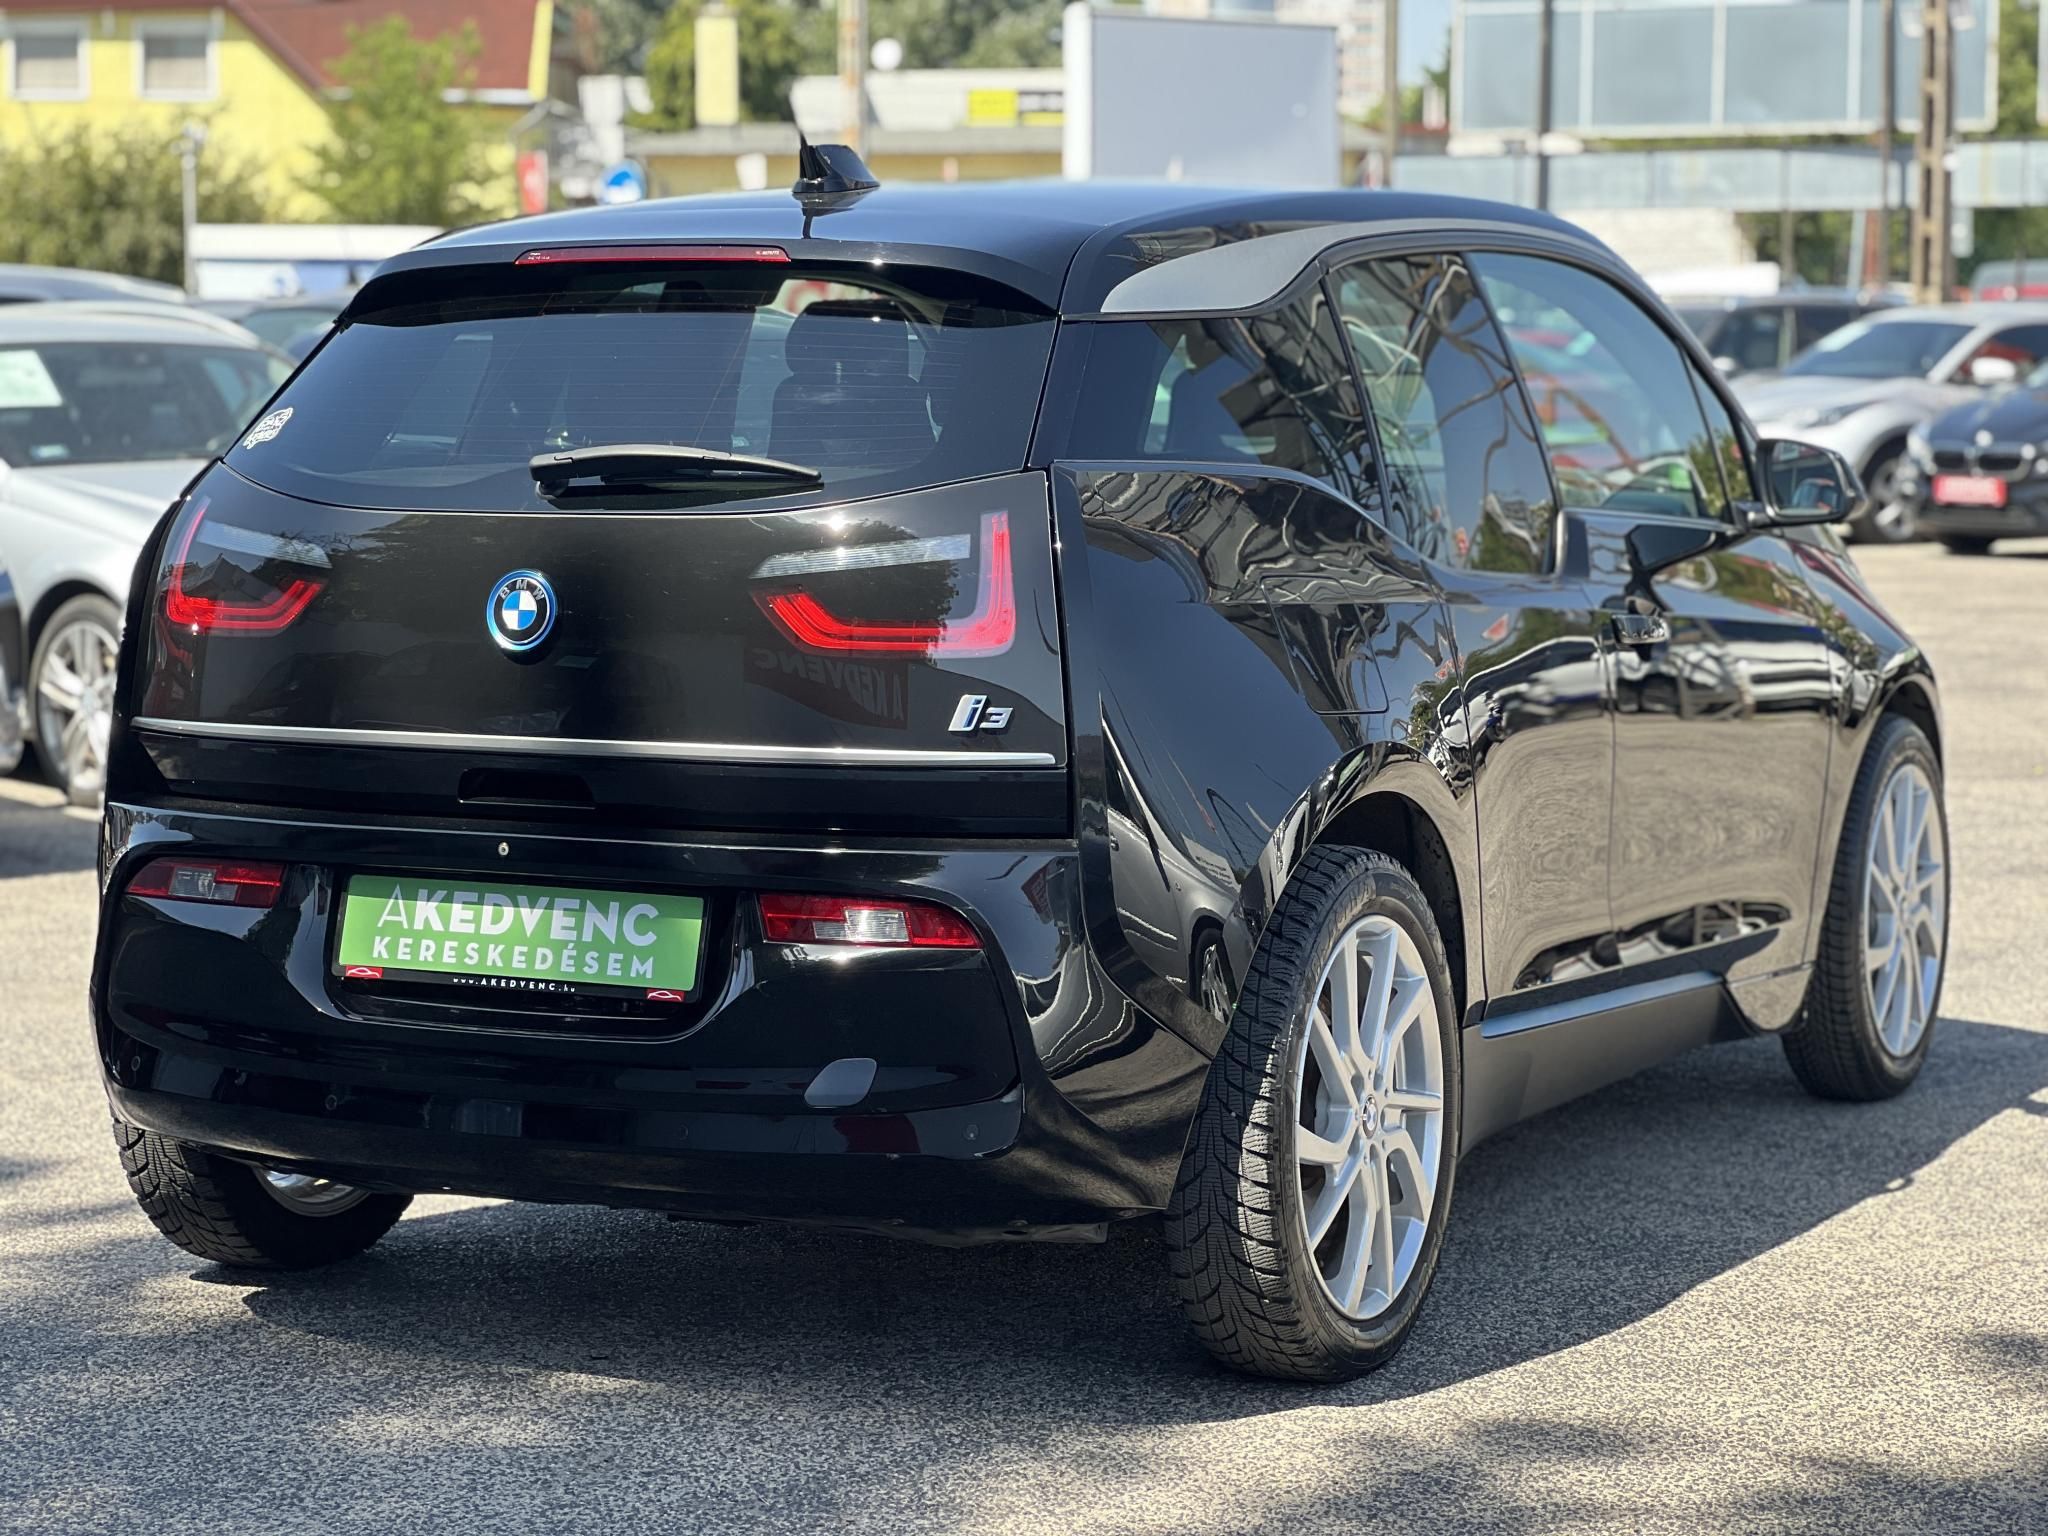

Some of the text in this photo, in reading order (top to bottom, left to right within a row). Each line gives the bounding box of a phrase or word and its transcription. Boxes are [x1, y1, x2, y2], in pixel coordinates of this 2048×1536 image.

[499, 579, 545, 601] BMW
[948, 694, 1013, 731] i3
[372, 936, 655, 979] KERESKEDÉSEM
[453, 978, 576, 992] www.AKEDVENC.hu
